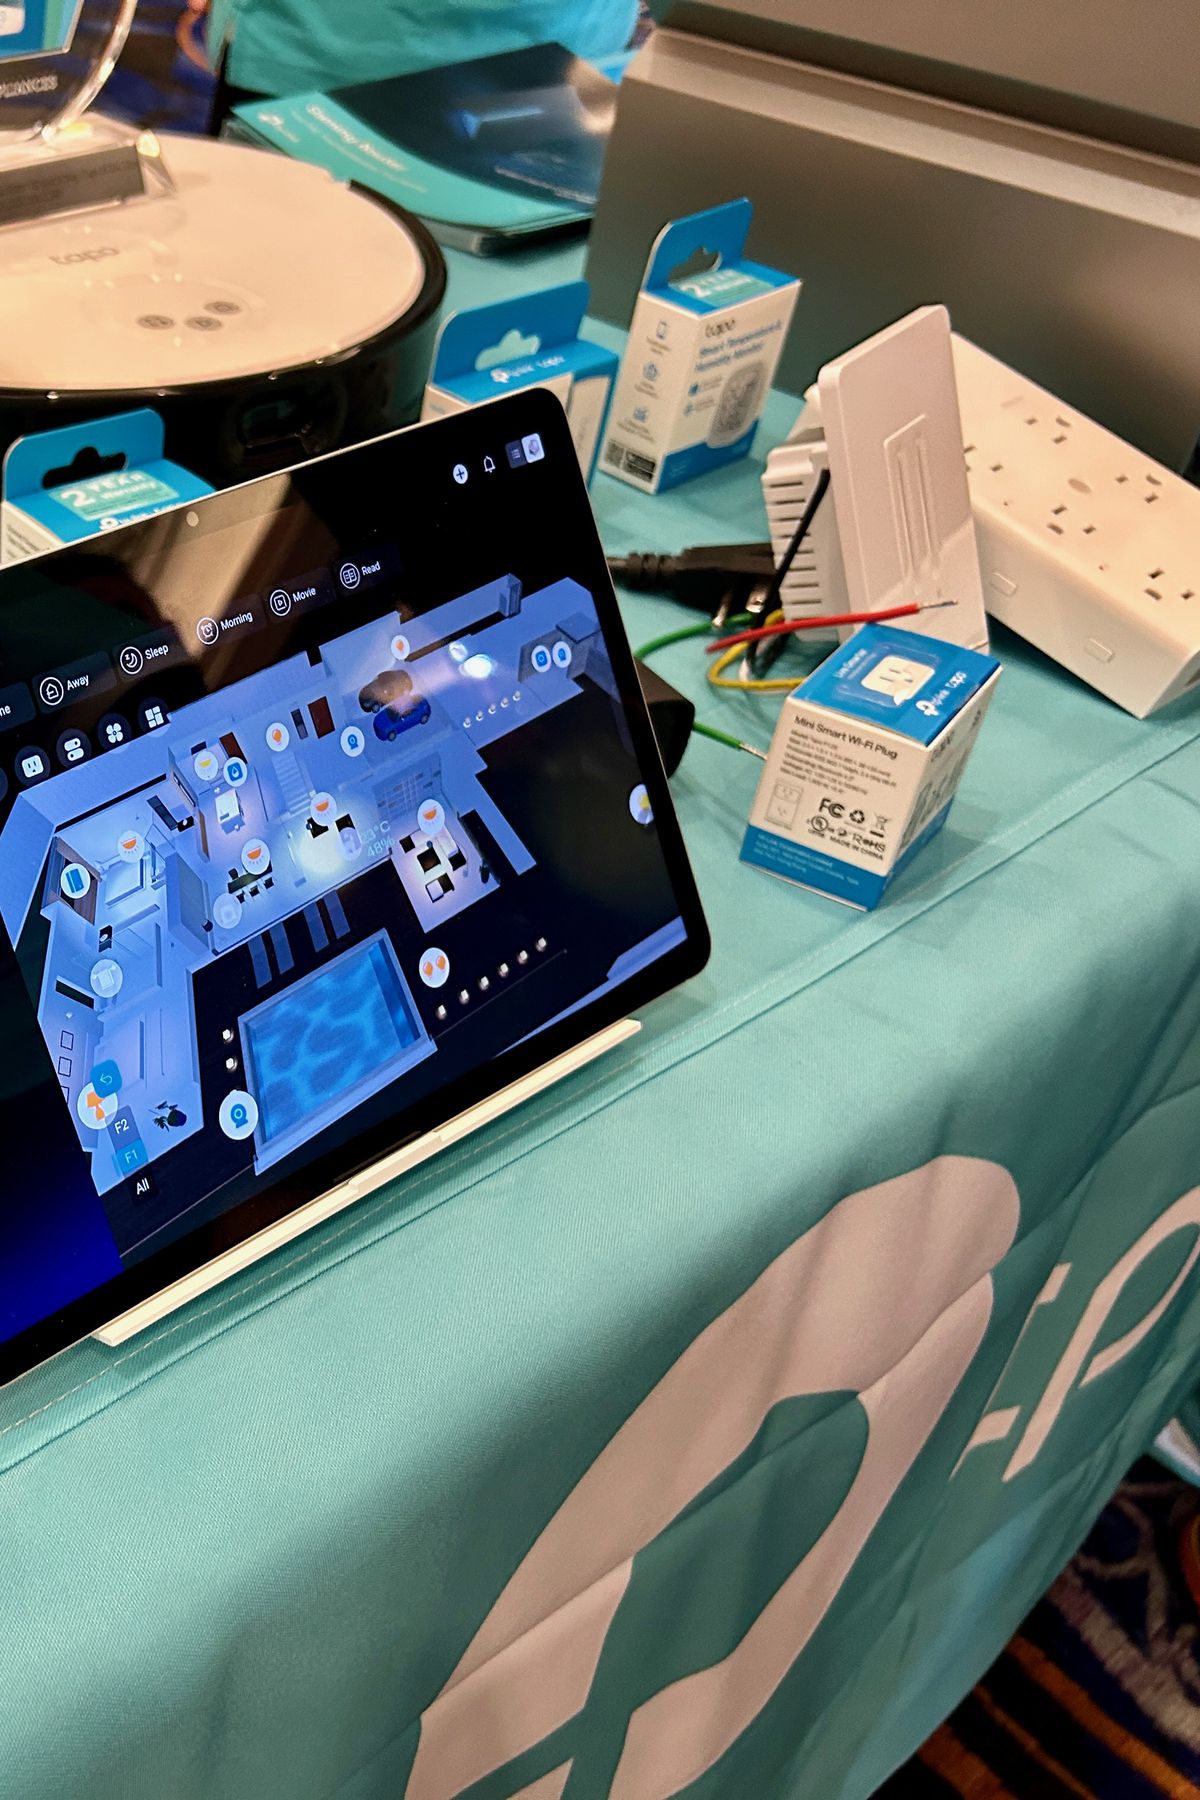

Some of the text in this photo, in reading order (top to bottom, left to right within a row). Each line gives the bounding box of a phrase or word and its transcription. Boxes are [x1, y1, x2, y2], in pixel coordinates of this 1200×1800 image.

[49, 247, 120, 265] tapo
[60, 489, 97, 508] 2
[361, 562, 381, 576] Read
[292, 586, 317, 604] Movie
[220, 610, 253, 631] Morning
[145, 643, 169, 662] Sleep
[66, 674, 90, 693] Away
[794, 716, 815, 729] Mini
[816, 723, 847, 741] Smart
[874, 744, 899, 761] Plug
[367, 835, 396, 858] 48%
[114, 1118, 130, 1134] F2
[125, 1149, 139, 1164] F1
[135, 1178, 150, 1194] All
